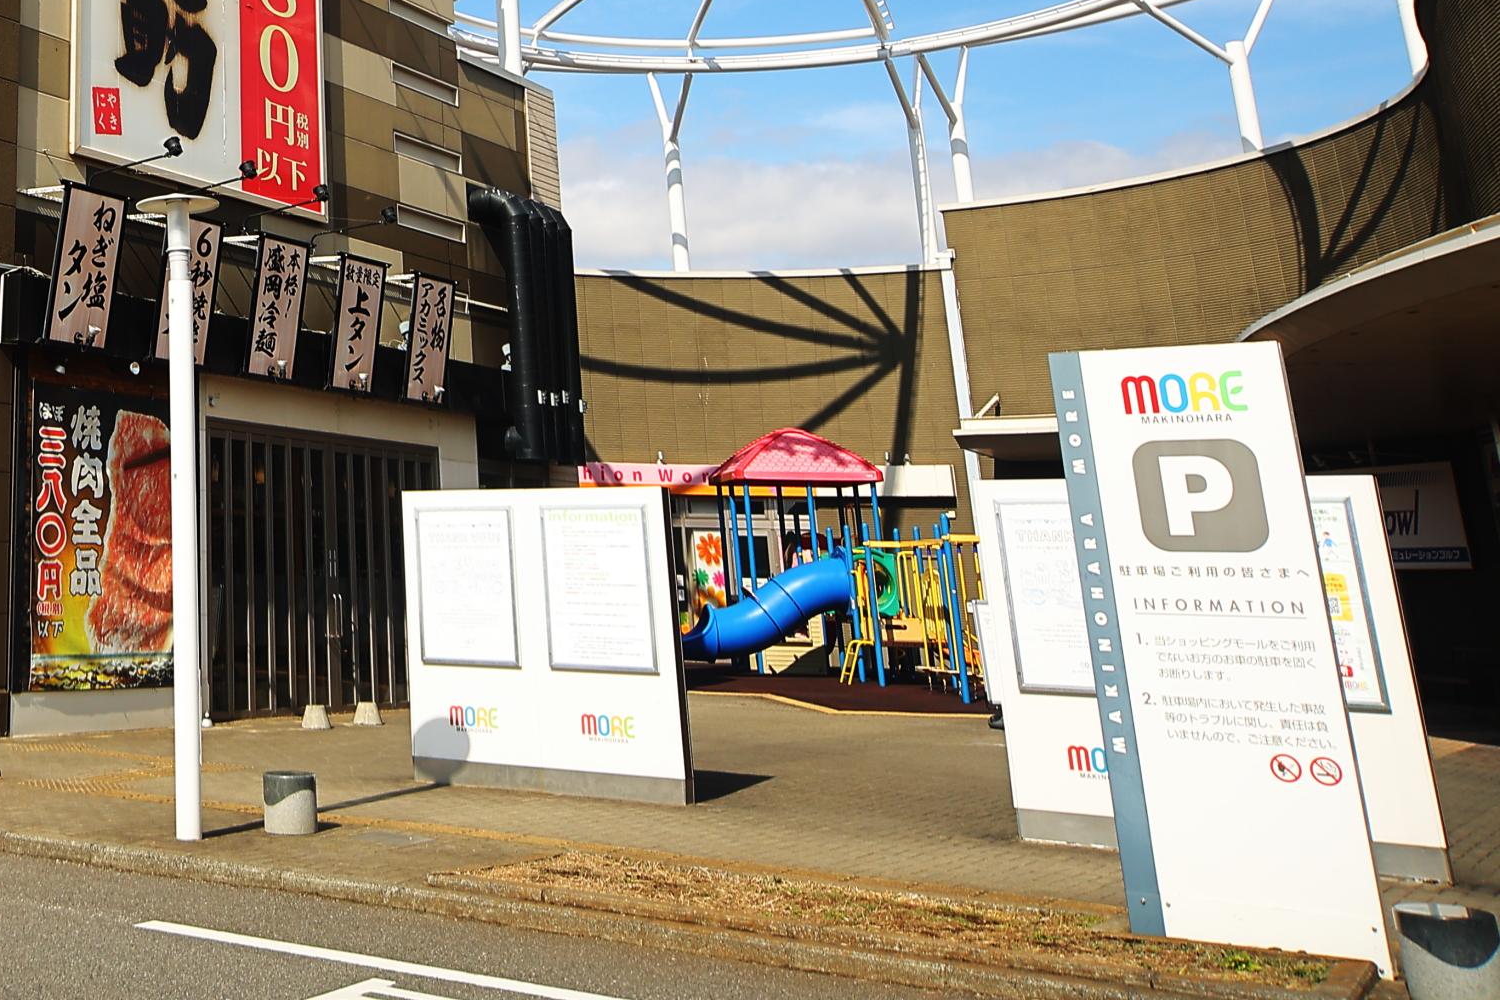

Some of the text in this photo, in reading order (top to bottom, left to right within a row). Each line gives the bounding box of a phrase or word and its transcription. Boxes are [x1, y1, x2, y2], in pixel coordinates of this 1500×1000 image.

[58, 239, 87, 321] タン
[81, 201, 116, 311] ねぎ塩
[346, 264, 381, 289] 数量限定
[345, 287, 371, 371] 上タン
[413, 282, 434, 384] アカミックス
[430, 287, 447, 352] 名物
[1121, 370, 1248, 415] MORE
[1141, 413, 1233, 424] MAKINOHARA
[1062, 389, 1086, 475] MORE
[70, 404, 103, 597] 焼肉全品
[1157, 455, 1234, 536] P
[1119, 565, 1310, 579] 駐車場ご利用の皆さまへ
[1133, 598, 1305, 614] INFORMATION
[1080, 512, 1127, 755] MAKINOHARA
[450, 705, 499, 728] MORE
[581, 713, 636, 739] MORE
